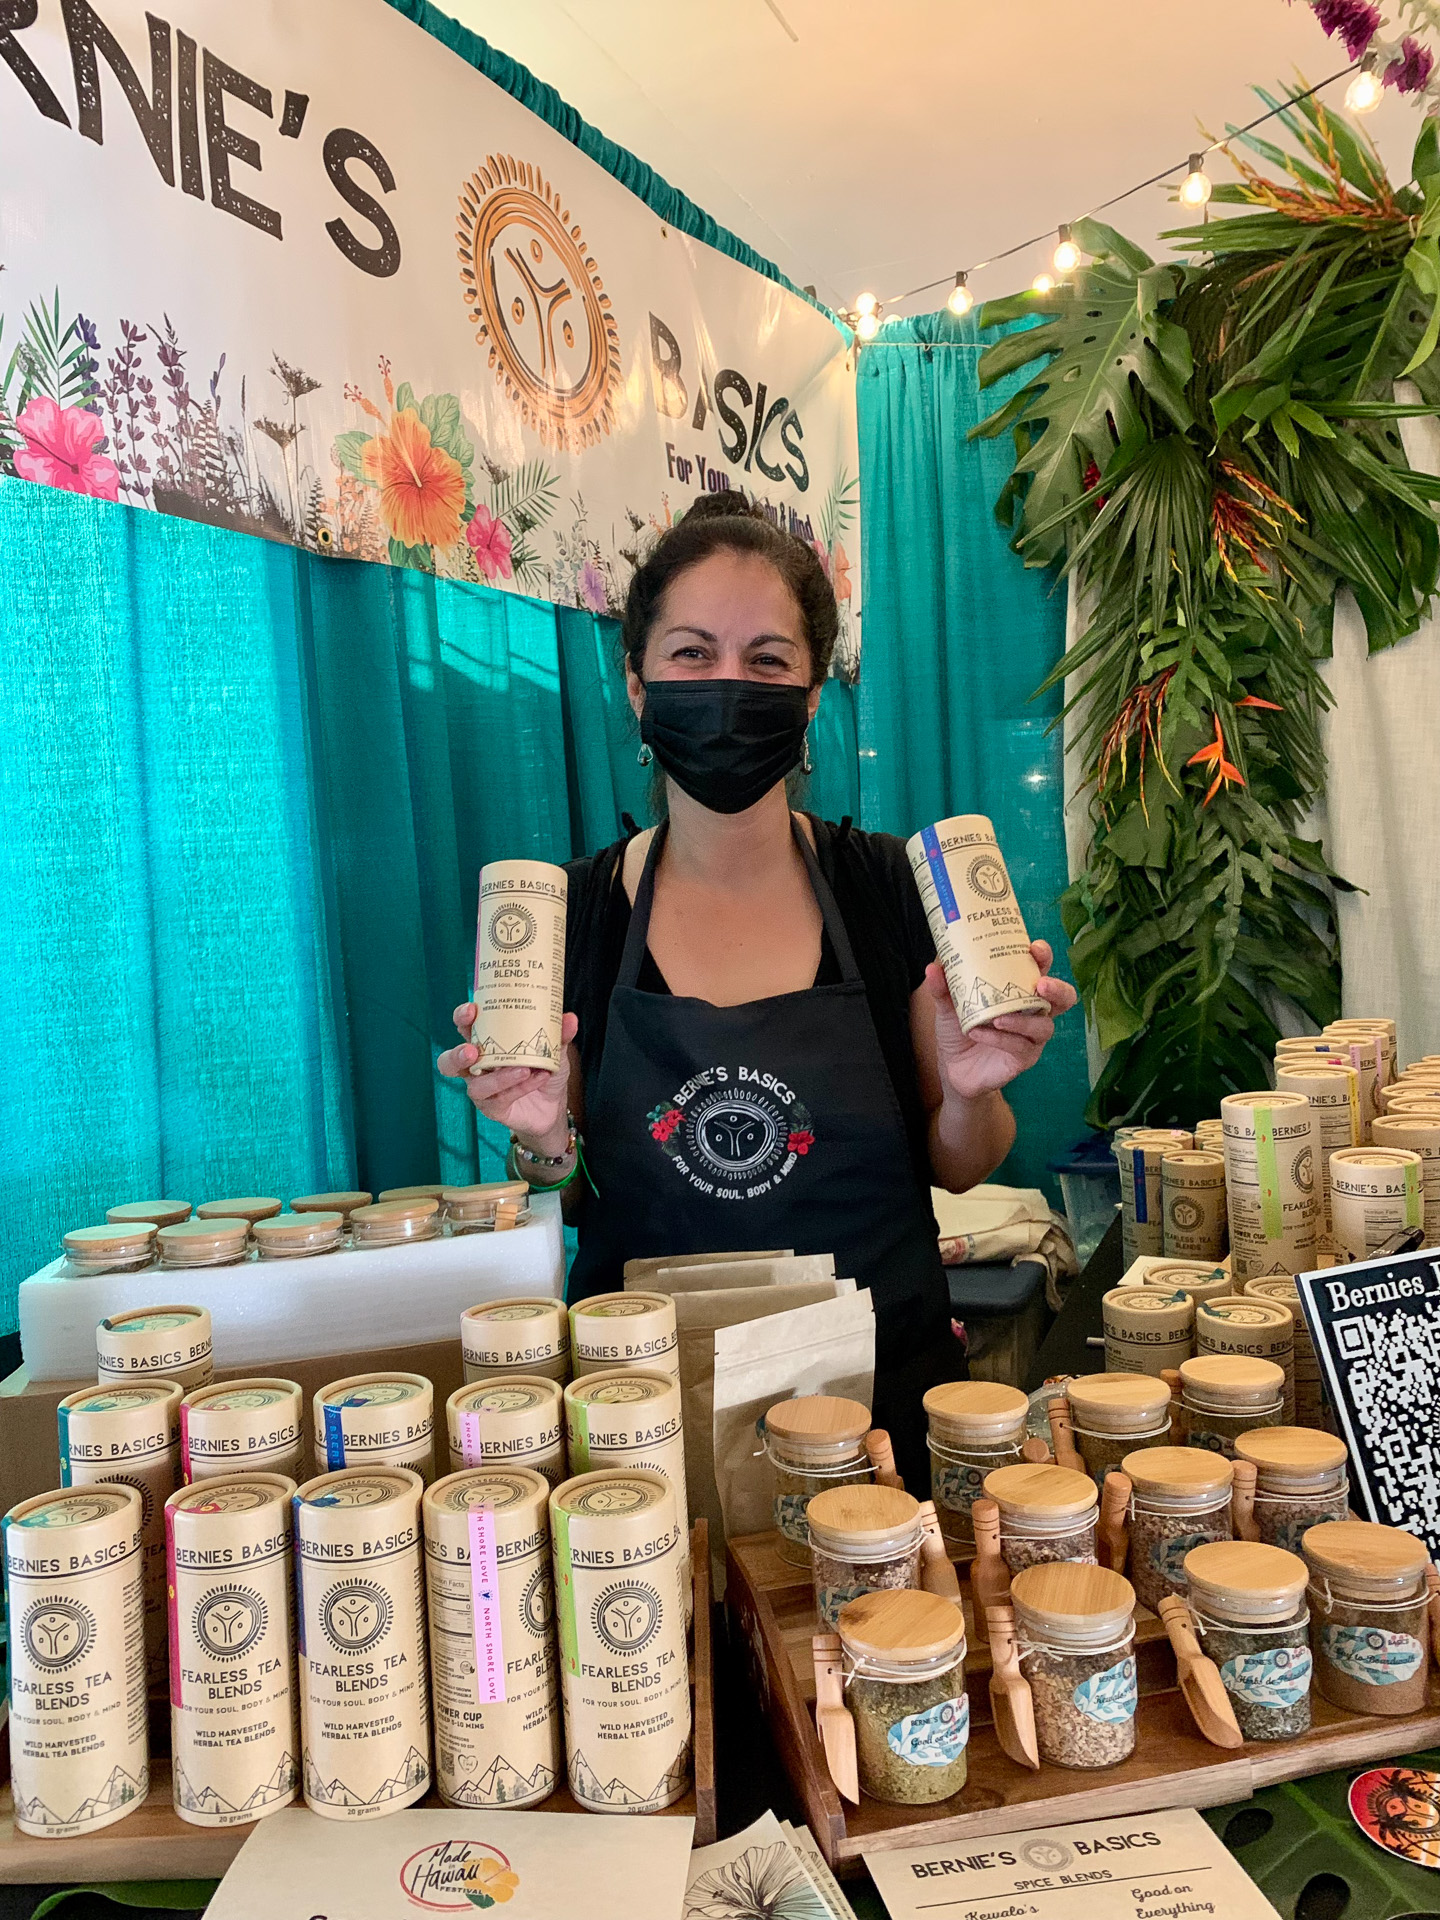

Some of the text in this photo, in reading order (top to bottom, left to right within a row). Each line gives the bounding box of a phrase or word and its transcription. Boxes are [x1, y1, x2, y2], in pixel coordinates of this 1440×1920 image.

[665, 442, 693, 485] For
[940, 833, 982, 849] BERNIES
[481, 880, 556, 895] BERNIES BASICS
[967, 907, 1012, 923] FEARLESS
[992, 917, 1020, 927] BLENDS
[480, 959, 544, 971] FEARLESS TEA
[494, 969, 530, 979] BLENDS
[672, 1066, 796, 1106] BERNIE'S BASICS
[1272, 1123, 1307, 1137] BERNIES
[672, 1155, 690, 1175] FOR
[689, 1174, 713, 1194] YOUR
[747, 1180, 772, 1199] BODY
[773, 1174, 782, 1184] &
[780, 1152, 798, 1176] MIND
[1336, 1179, 1378, 1194] BERNIE'S
[1121, 1329, 1161, 1342] BASICS
[464, 1344, 552, 1364] BERNIES BASICS
[625, 1335, 668, 1357] BASICS
[1220, 1342, 1263, 1354] BASICS
[130, 1351, 182, 1368] BASICS
[188, 1425, 295, 1452] BERNIES BASICS
[343, 1430, 400, 1446] BERNIES
[464, 1422, 474, 1449] SHORE
[635, 1419, 676, 1443] BASICS
[111, 1433, 165, 1456] BASICS
[478, 1436, 534, 1454] BERNIES
[176, 1548, 233, 1564] BERNIES
[242, 1529, 291, 1559] BASICS
[300, 1527, 413, 1557] BERNIES BASICS
[496, 1528, 546, 1558] BERNIES
[623, 1533, 670, 1562] BASICS
[8, 1555, 60, 1573] BERNIES
[69, 1541, 126, 1570] BASICS
[477, 1526, 489, 1584] SHORE LOVE
[483, 1607, 497, 1700] NORTH SHORE LOVE
[182, 1658, 282, 1685] FEARLESS TEA
[310, 1652, 408, 1678] FEARLESS TEA
[581, 1649, 676, 1679] FEARLESS TEA
[13, 1671, 112, 1695] FEARLESS TEA
[208, 1680, 263, 1700] BLENDS
[335, 1674, 388, 1693] BLENDS
[611, 1672, 661, 1693] BLENDS
[35, 1693, 90, 1711] BLENDS
[195, 1706, 214, 1715] YOUR
[241, 1699, 263, 1711] BODY
[273, 1687, 289, 1700] MIND
[310, 1694, 321, 1703] FOR
[322, 1699, 341, 1707] YOUR
[368, 1692, 390, 1705] BODY
[399, 1681, 415, 1695] MIND
[506, 1684, 541, 1704] FOR YOUR
[582, 1697, 595, 1706] FOR
[643, 1693, 663, 1704] BODY
[67, 1712, 91, 1724] BODY
[102, 1701, 121, 1714] MIND
[324, 1714, 395, 1731] WILD HARVESTED
[463, 1712, 482, 1722] CUP
[522, 1713, 548, 1732] HERBAL
[525, 1708, 544, 1722] WILD
[599, 1711, 669, 1731] WILD HARVESTED
[193, 1726, 276, 1748] HERBAL TEA BLENDS
[196, 1720, 269, 1738] WILD HARVESTED
[321, 1721, 403, 1740] HERBAL TEA BLENDS
[597, 1717, 675, 1740] HERBAL TEA BLENDS
[23, 1741, 105, 1759] HERBAL TEA BLENDS
[25, 1734, 97, 1749] WILD HARVESTED
[229, 1812, 253, 1824] grams
[357, 1805, 381, 1817] grams
[627, 1802, 659, 1814] 20 grams
[56, 1825, 80, 1835] grams
[428, 1840, 472, 1867] Made
[910, 1831, 1162, 1878] BERNIE'S BASICS
[411, 1858, 483, 1898] Hawaii
[1013, 1869, 1113, 1892] SPICE BLENDS
[440, 1886, 483, 1895] FESTIVAL
[1130, 1884, 1194, 1903] Good on
[964, 1904, 1040, 1920] Kewalo's
[1135, 1900, 1216, 1920] Everything
